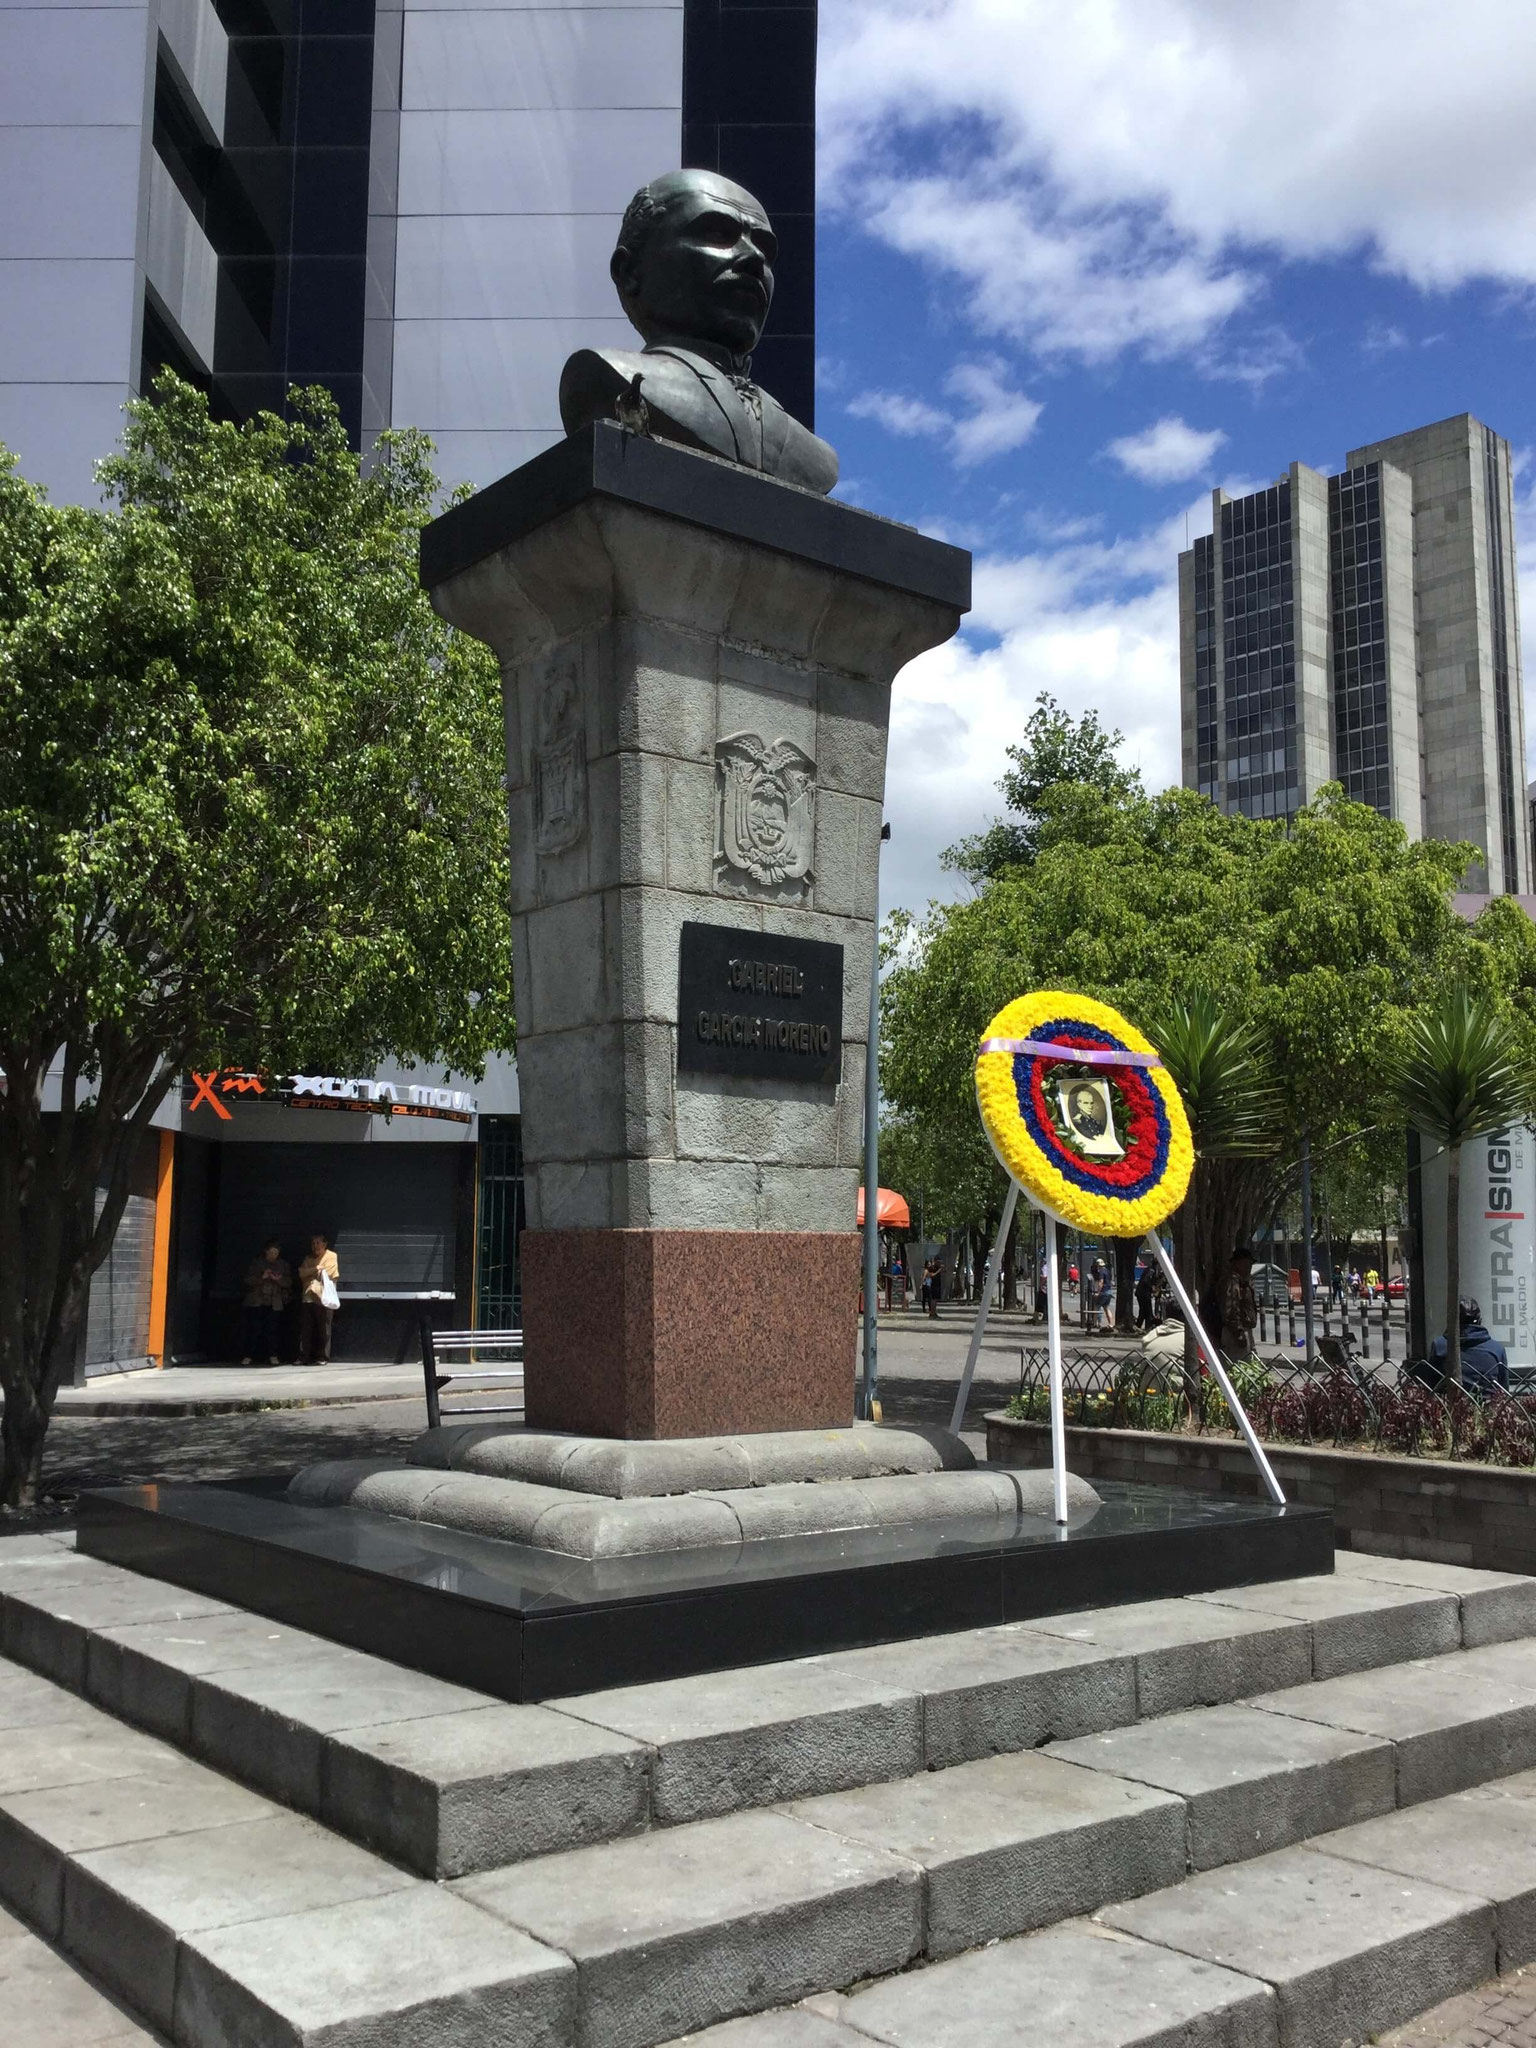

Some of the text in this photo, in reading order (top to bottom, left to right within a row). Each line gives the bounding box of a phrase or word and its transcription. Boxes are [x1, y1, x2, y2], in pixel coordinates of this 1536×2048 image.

[731, 959, 803, 995] GABRIEL
[699, 1010, 831, 1051] GARCIA MORENO
[408, 1084, 477, 1112] MOVIL
[1515, 1149, 1523, 1169] DE
[1489, 1221, 1516, 1348] LETRA
[1518, 1275, 1528, 1326] MEDIO
[1519, 1330, 1528, 1348] EL
